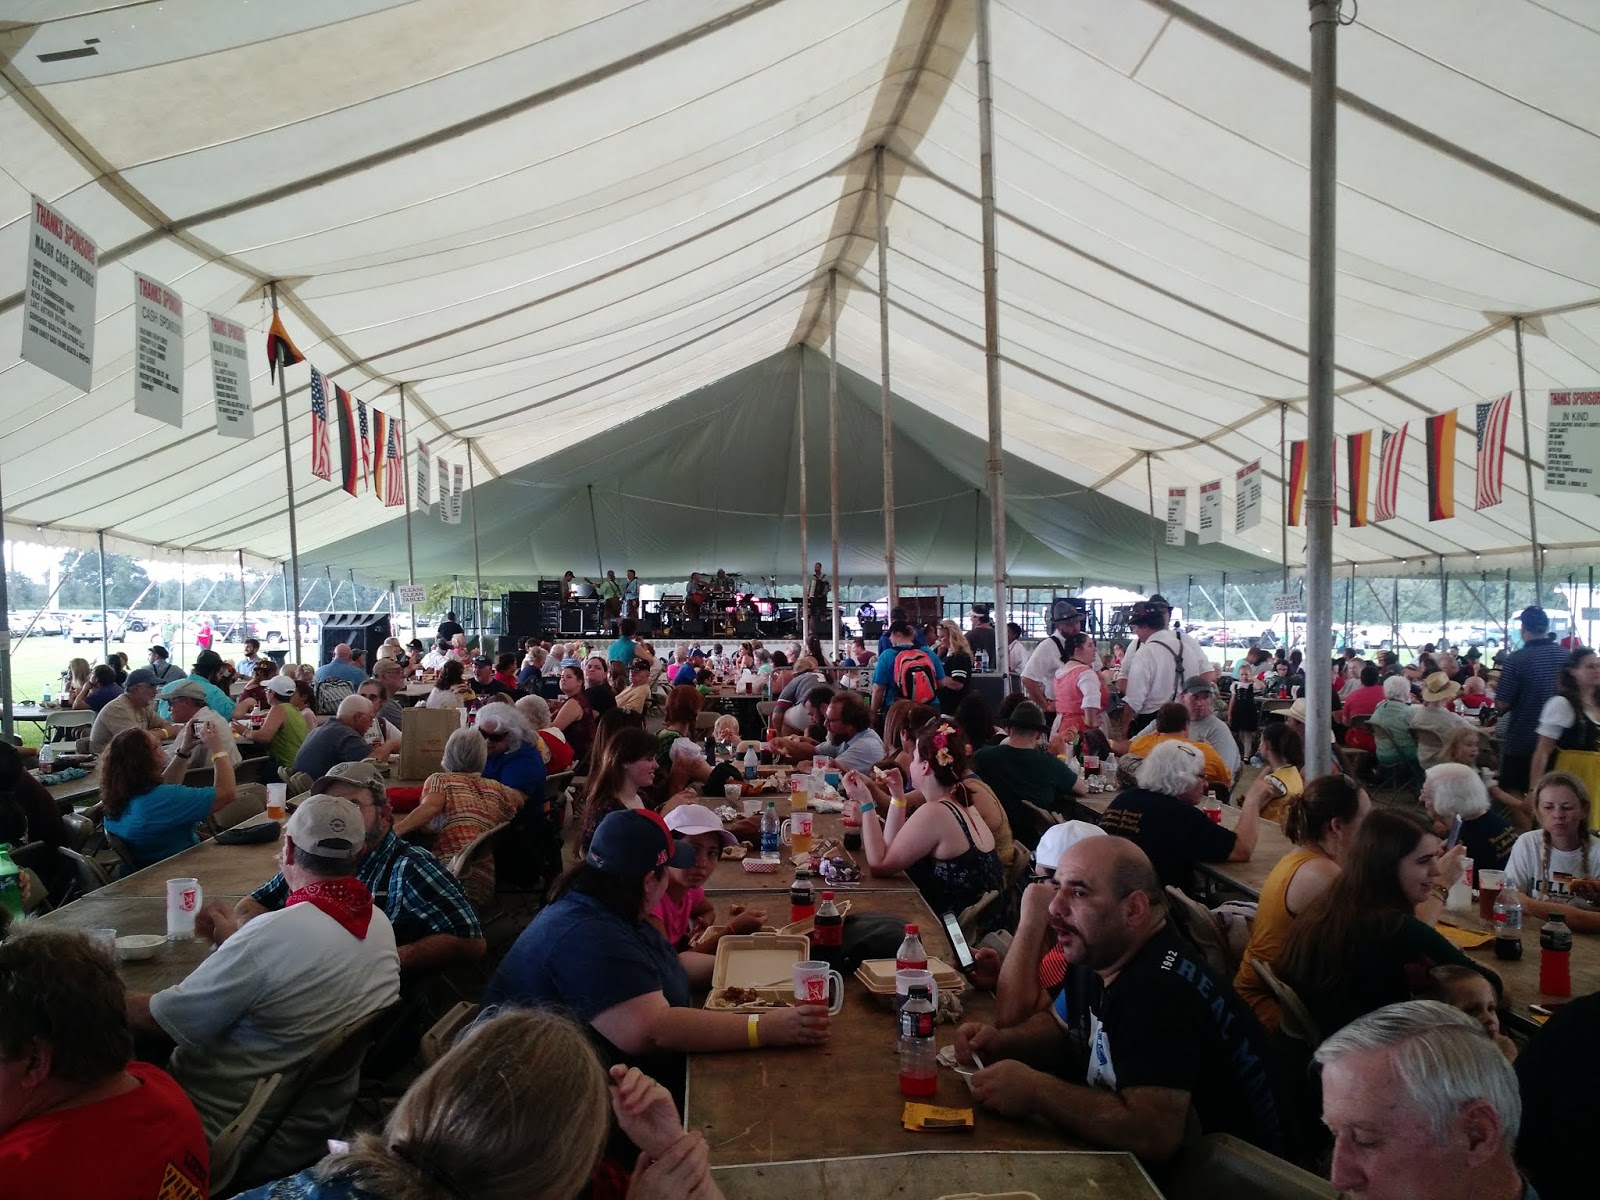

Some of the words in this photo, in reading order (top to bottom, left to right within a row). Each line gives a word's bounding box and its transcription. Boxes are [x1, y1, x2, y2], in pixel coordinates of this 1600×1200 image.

[36, 202, 63, 240] THANKS
[64, 224, 96, 265] SPONSORS
[35, 234, 54, 259] MAJOR
[55, 248, 70, 269] CASH
[70, 260, 94, 288] SPONSORS
[139, 278, 162, 305] THANKS
[1550, 393, 1571, 405] THANKS
[1563, 412, 1570, 421] IN
[1572, 412, 1589, 421] KIND
[1161, 950, 1178, 971] 1902
